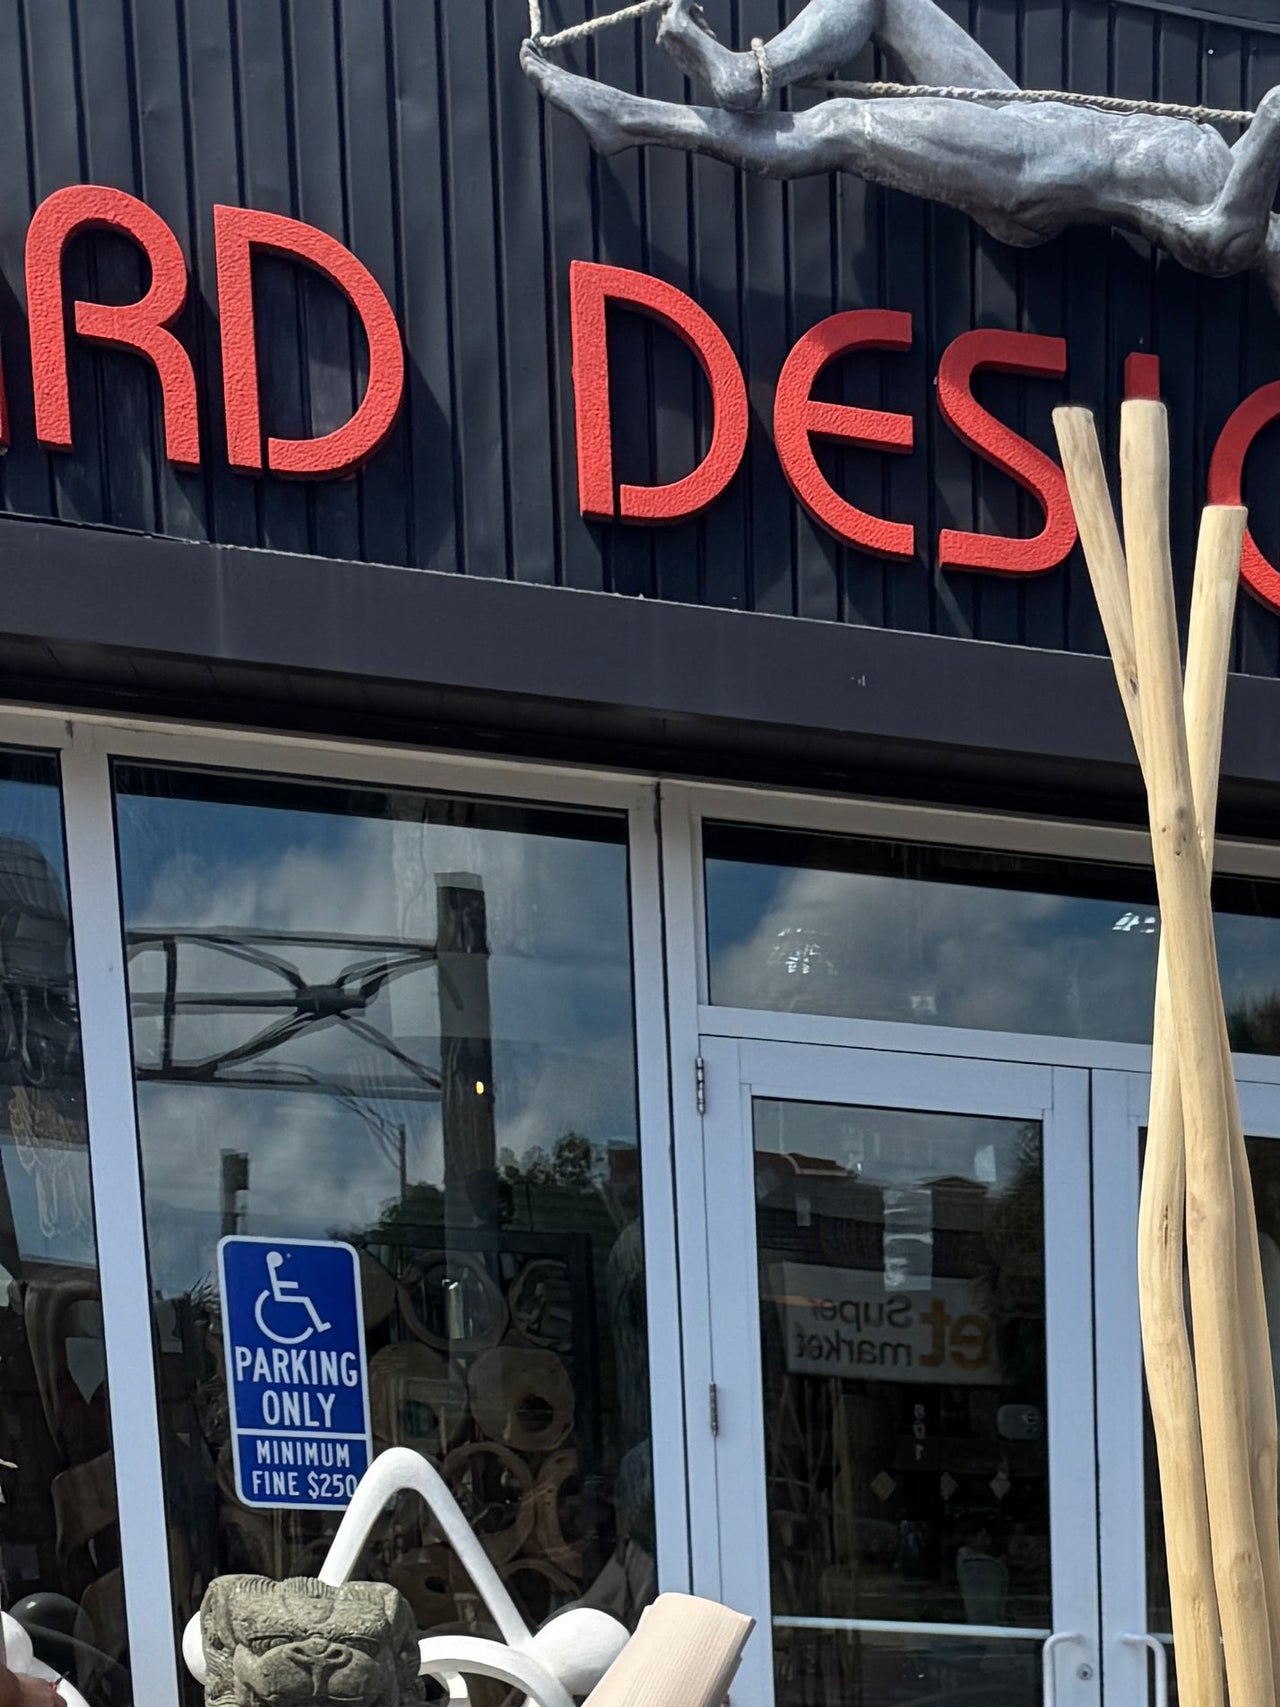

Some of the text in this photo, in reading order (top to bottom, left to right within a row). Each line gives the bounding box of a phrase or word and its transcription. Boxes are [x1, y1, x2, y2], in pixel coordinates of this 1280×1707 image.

[0, 184, 405, 481] RD
[234, 1346, 358, 1387] PARKING
[262, 1390, 336, 1428] ONLY
[256, 1440, 350, 1468] MINIMUM
[252, 1471, 358, 1499] FINE $250
